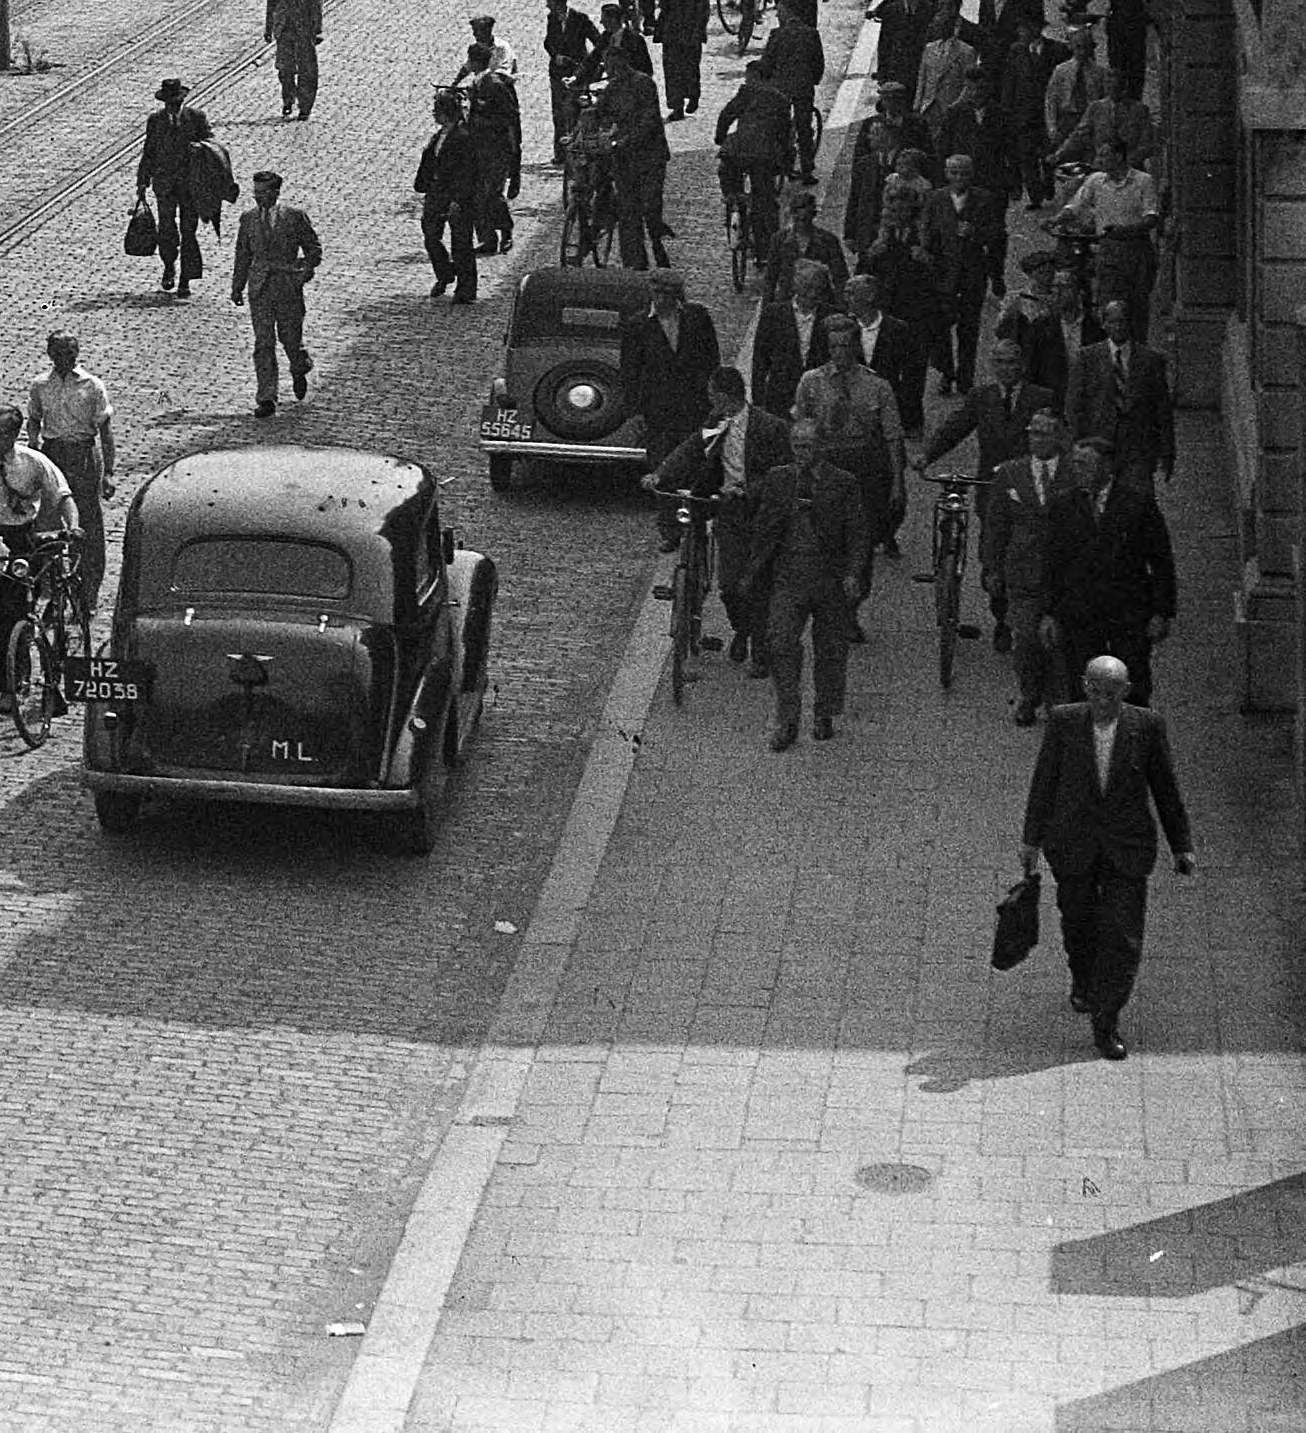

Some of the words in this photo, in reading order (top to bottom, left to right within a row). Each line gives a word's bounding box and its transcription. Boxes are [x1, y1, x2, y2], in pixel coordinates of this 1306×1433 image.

[497, 408, 518, 424] HZ
[481, 421, 532, 440] 55645
[90, 662, 118, 678] HZ
[74, 680, 138, 699] 72038
